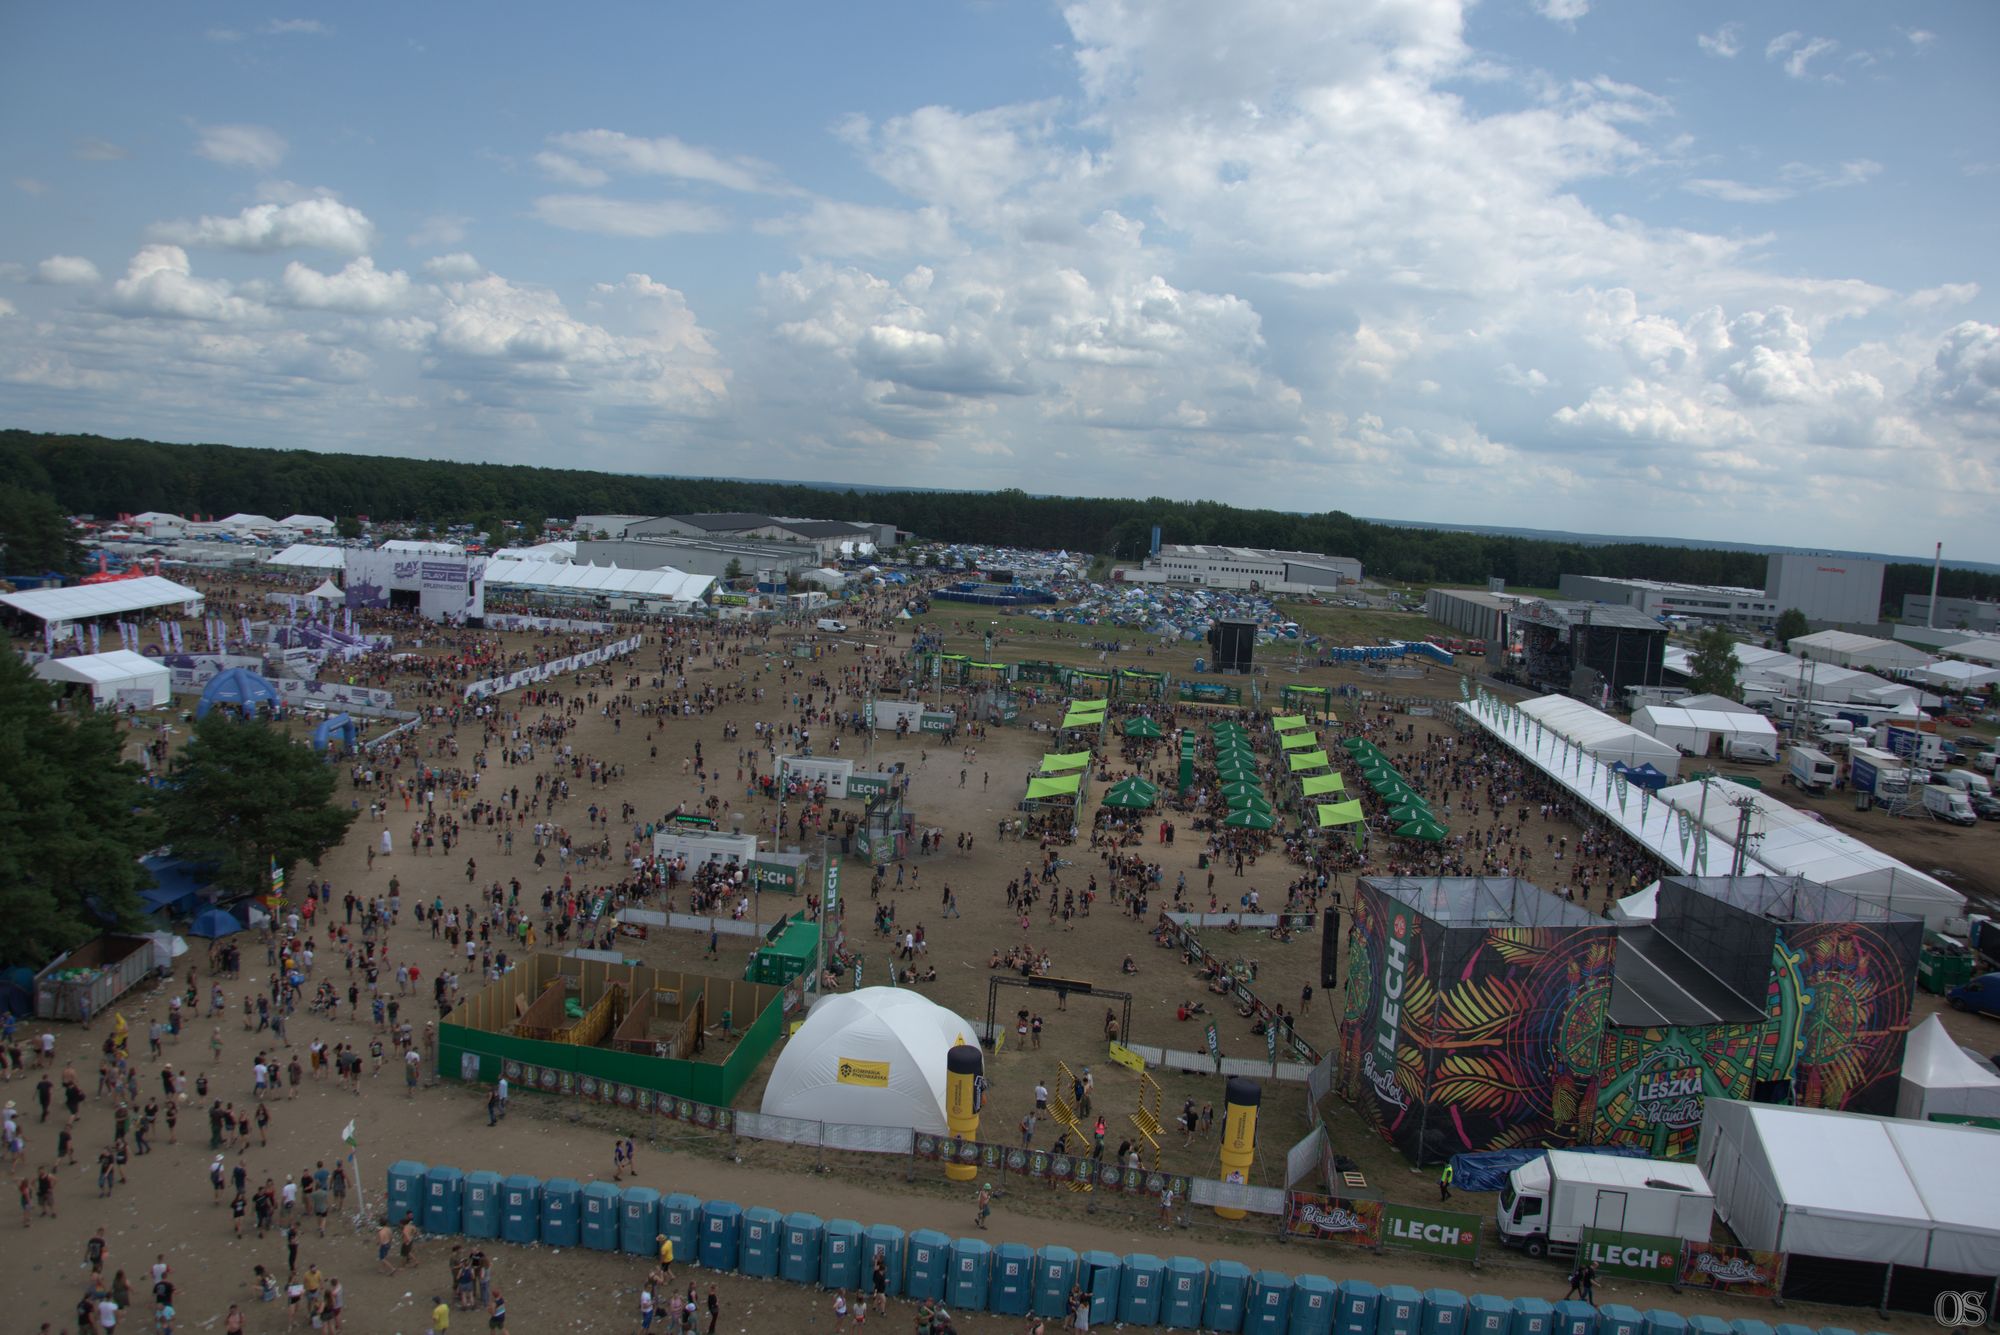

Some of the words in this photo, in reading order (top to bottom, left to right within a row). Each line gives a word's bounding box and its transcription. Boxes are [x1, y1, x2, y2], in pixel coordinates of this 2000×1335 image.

[394, 560, 419, 571] PLAY
[923, 721, 945, 730] LECH
[851, 783, 879, 795] LECH
[828, 867, 838, 911] LECH
[591, 899, 605, 920] LECH
[1378, 937, 1406, 1053] LECH
[1638, 1078, 1703, 1102] LESZKA
[1394, 1218, 1460, 1245] LECH
[1591, 1243, 1659, 1269] LECH
